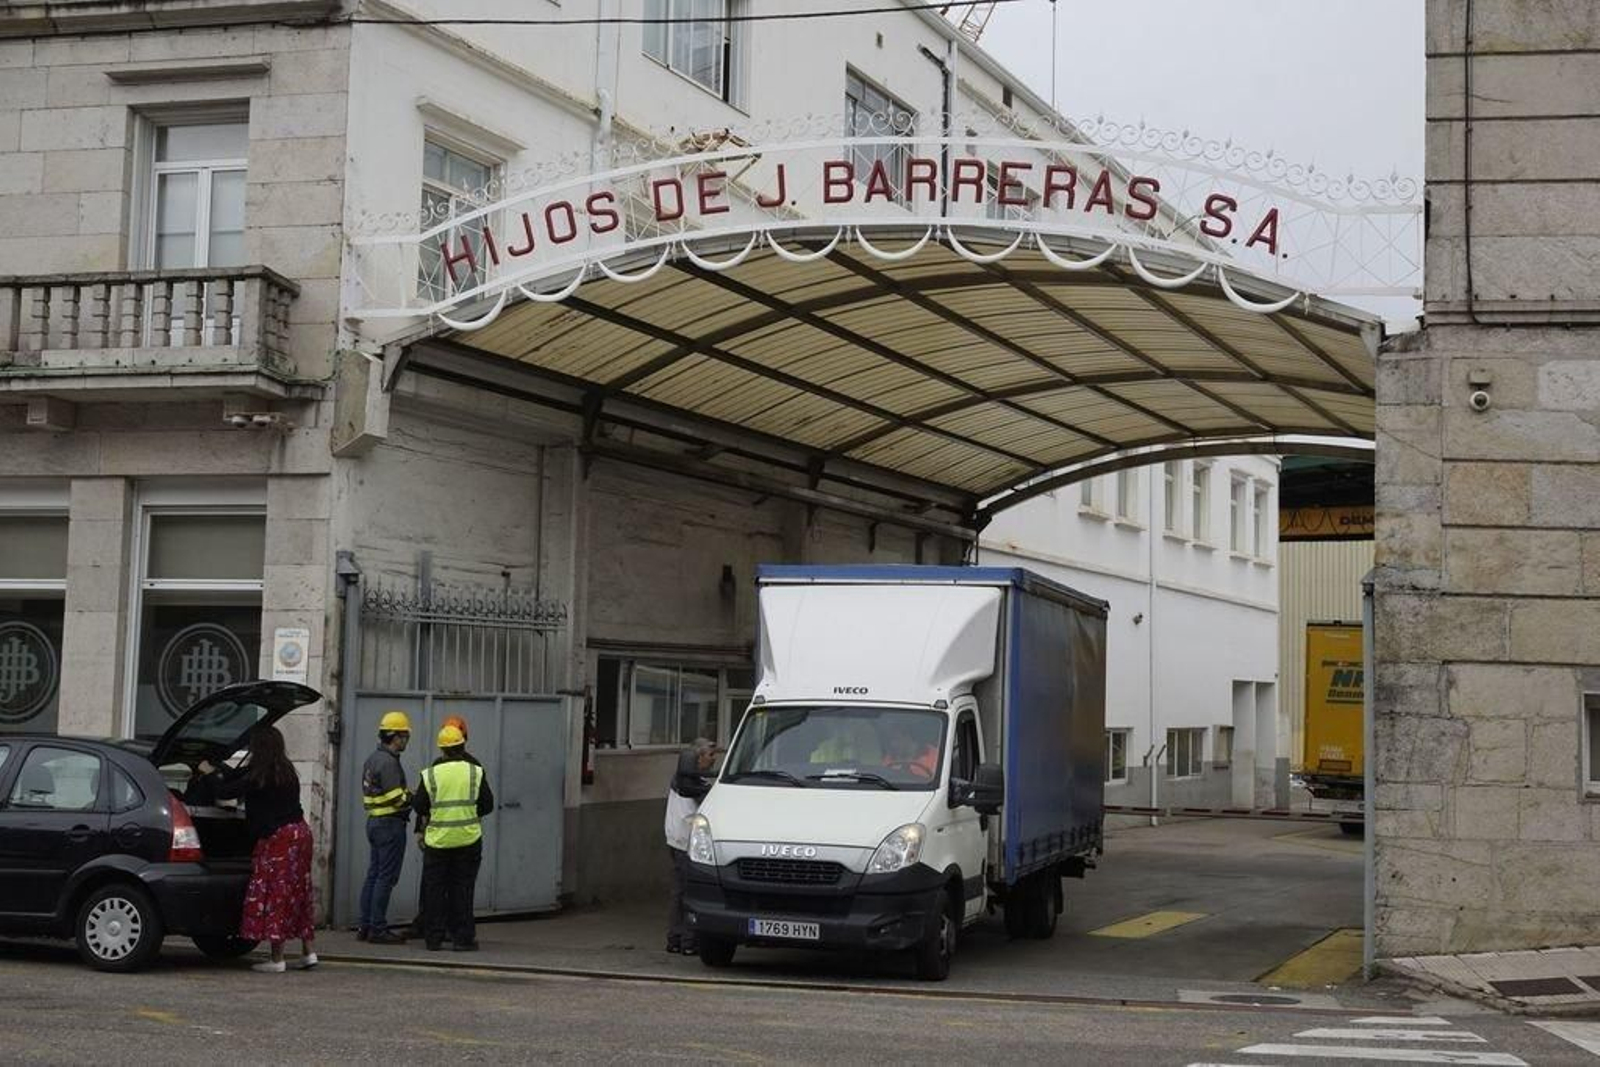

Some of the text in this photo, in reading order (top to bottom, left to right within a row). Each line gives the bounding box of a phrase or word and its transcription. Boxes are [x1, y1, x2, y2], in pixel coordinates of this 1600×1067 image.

[440, 190, 620, 282] HIJOS
[652, 170, 730, 222] DE
[756, 163, 797, 208] J.
[822, 157, 1161, 221] BARRERAS
[833, 686, 869, 695] IVECO
[761, 844, 817, 858] IVECO
[759, 921, 818, 938] 1769 HYN
